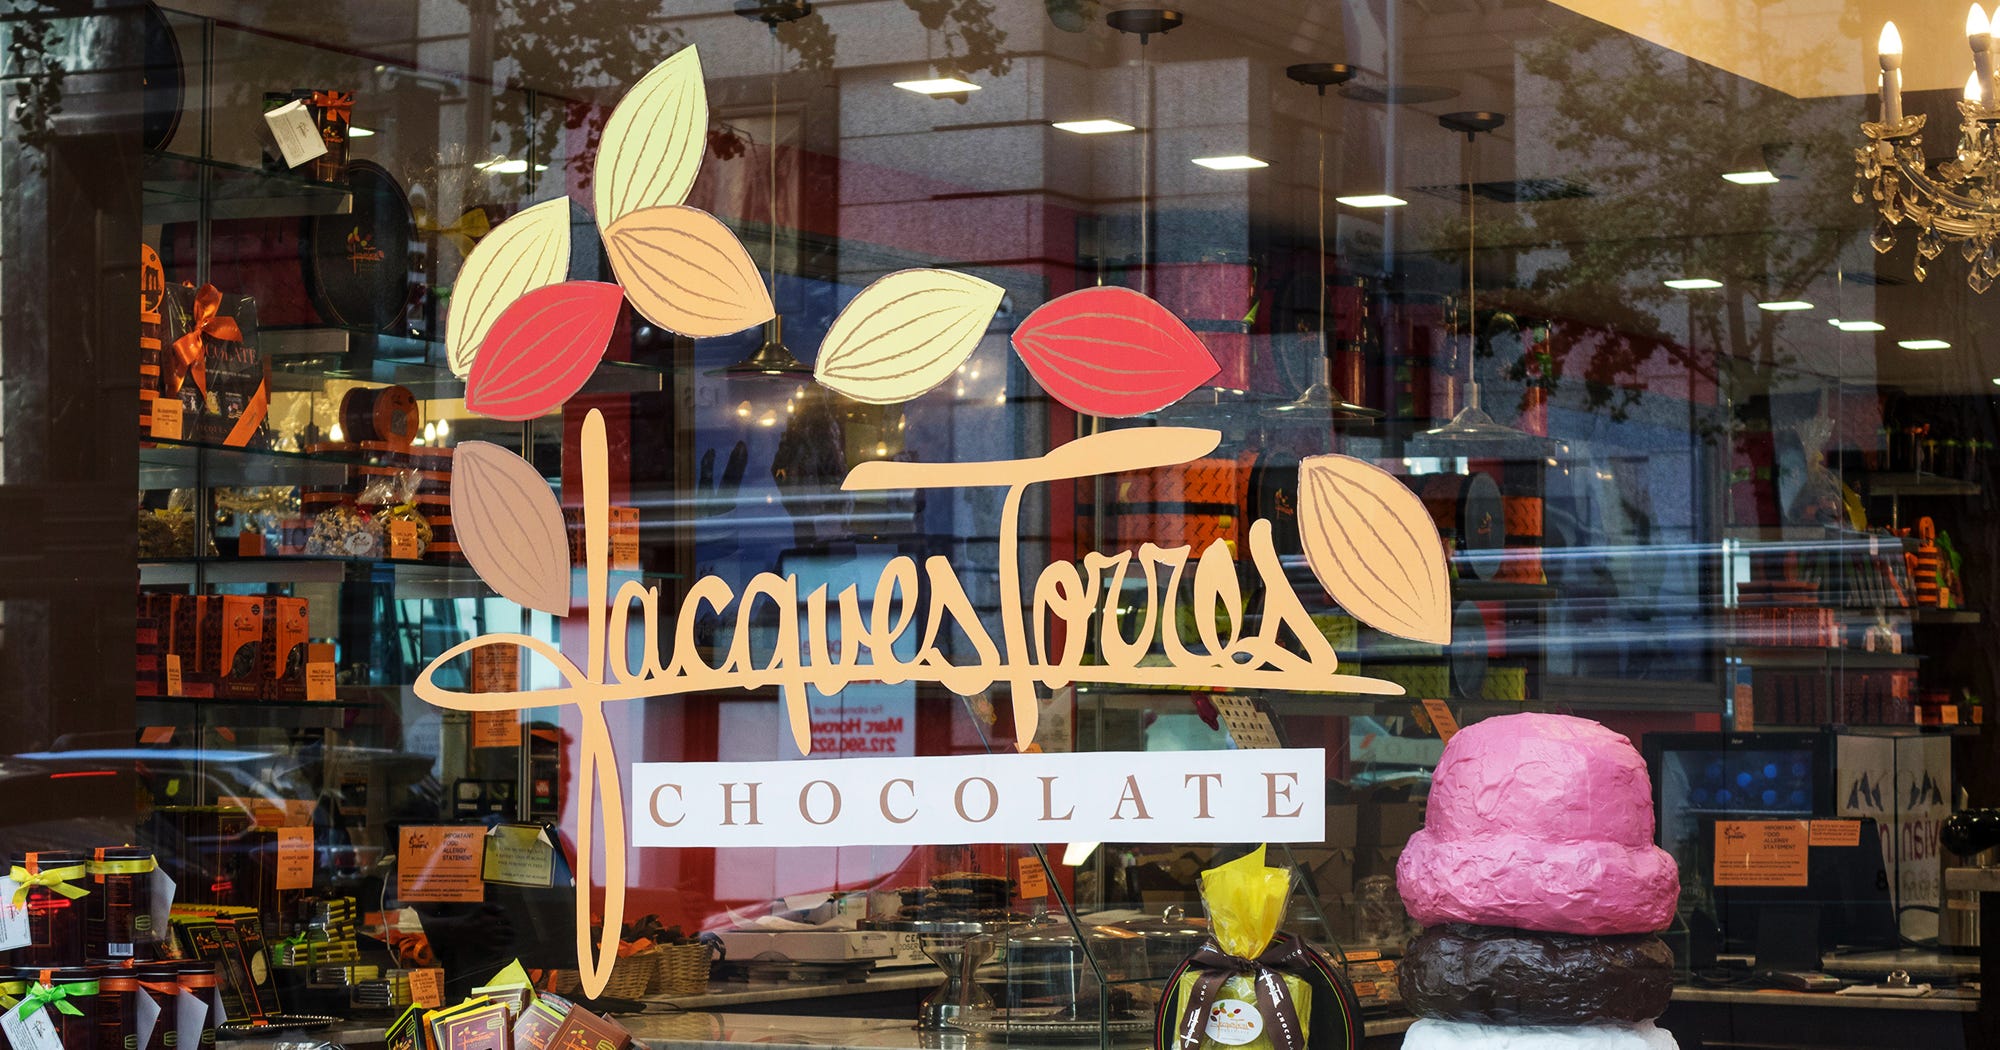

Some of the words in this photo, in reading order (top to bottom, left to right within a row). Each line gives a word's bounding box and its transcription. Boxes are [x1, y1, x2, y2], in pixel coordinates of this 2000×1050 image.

[414, 408, 1002, 1000] Jacques
[840, 427, 1405, 753] Torres
[649, 772, 1306, 829] CHOCOLATE
